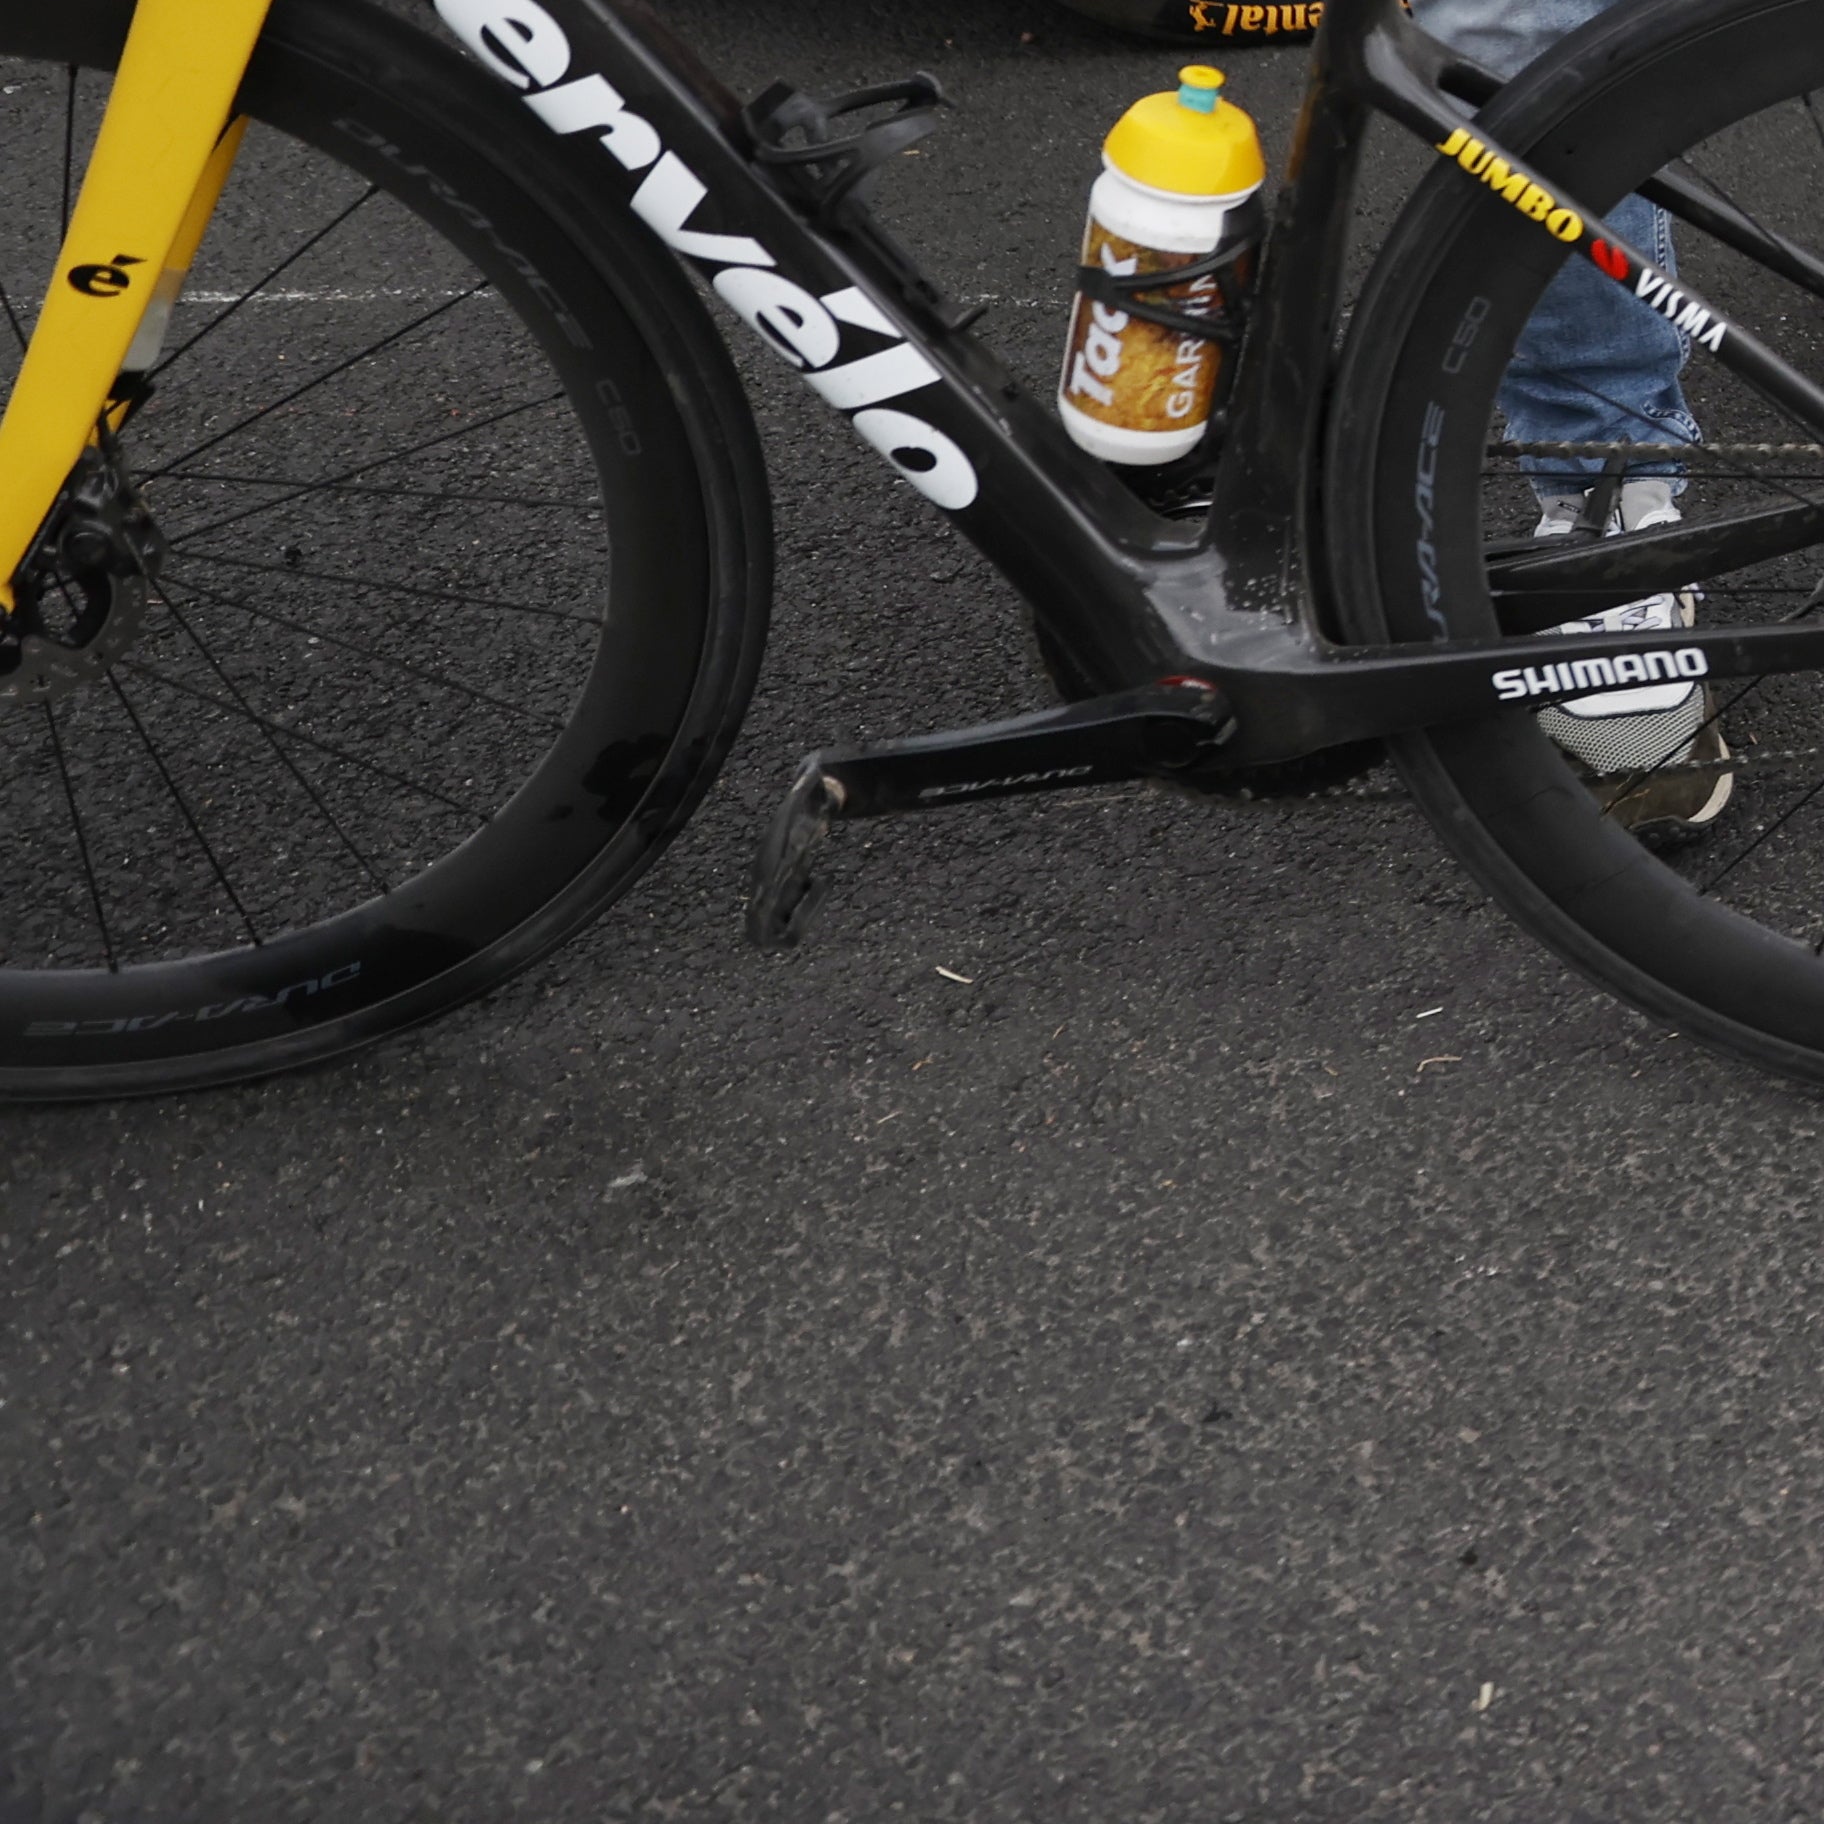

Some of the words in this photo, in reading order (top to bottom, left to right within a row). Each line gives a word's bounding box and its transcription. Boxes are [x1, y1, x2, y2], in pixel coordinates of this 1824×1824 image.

[1435, 126, 1584, 244] JUMBO
[1633, 265, 1729, 355] VISMA
[1441, 296, 1492, 375] C50
[1492, 647, 1709, 701] SHIMANO
